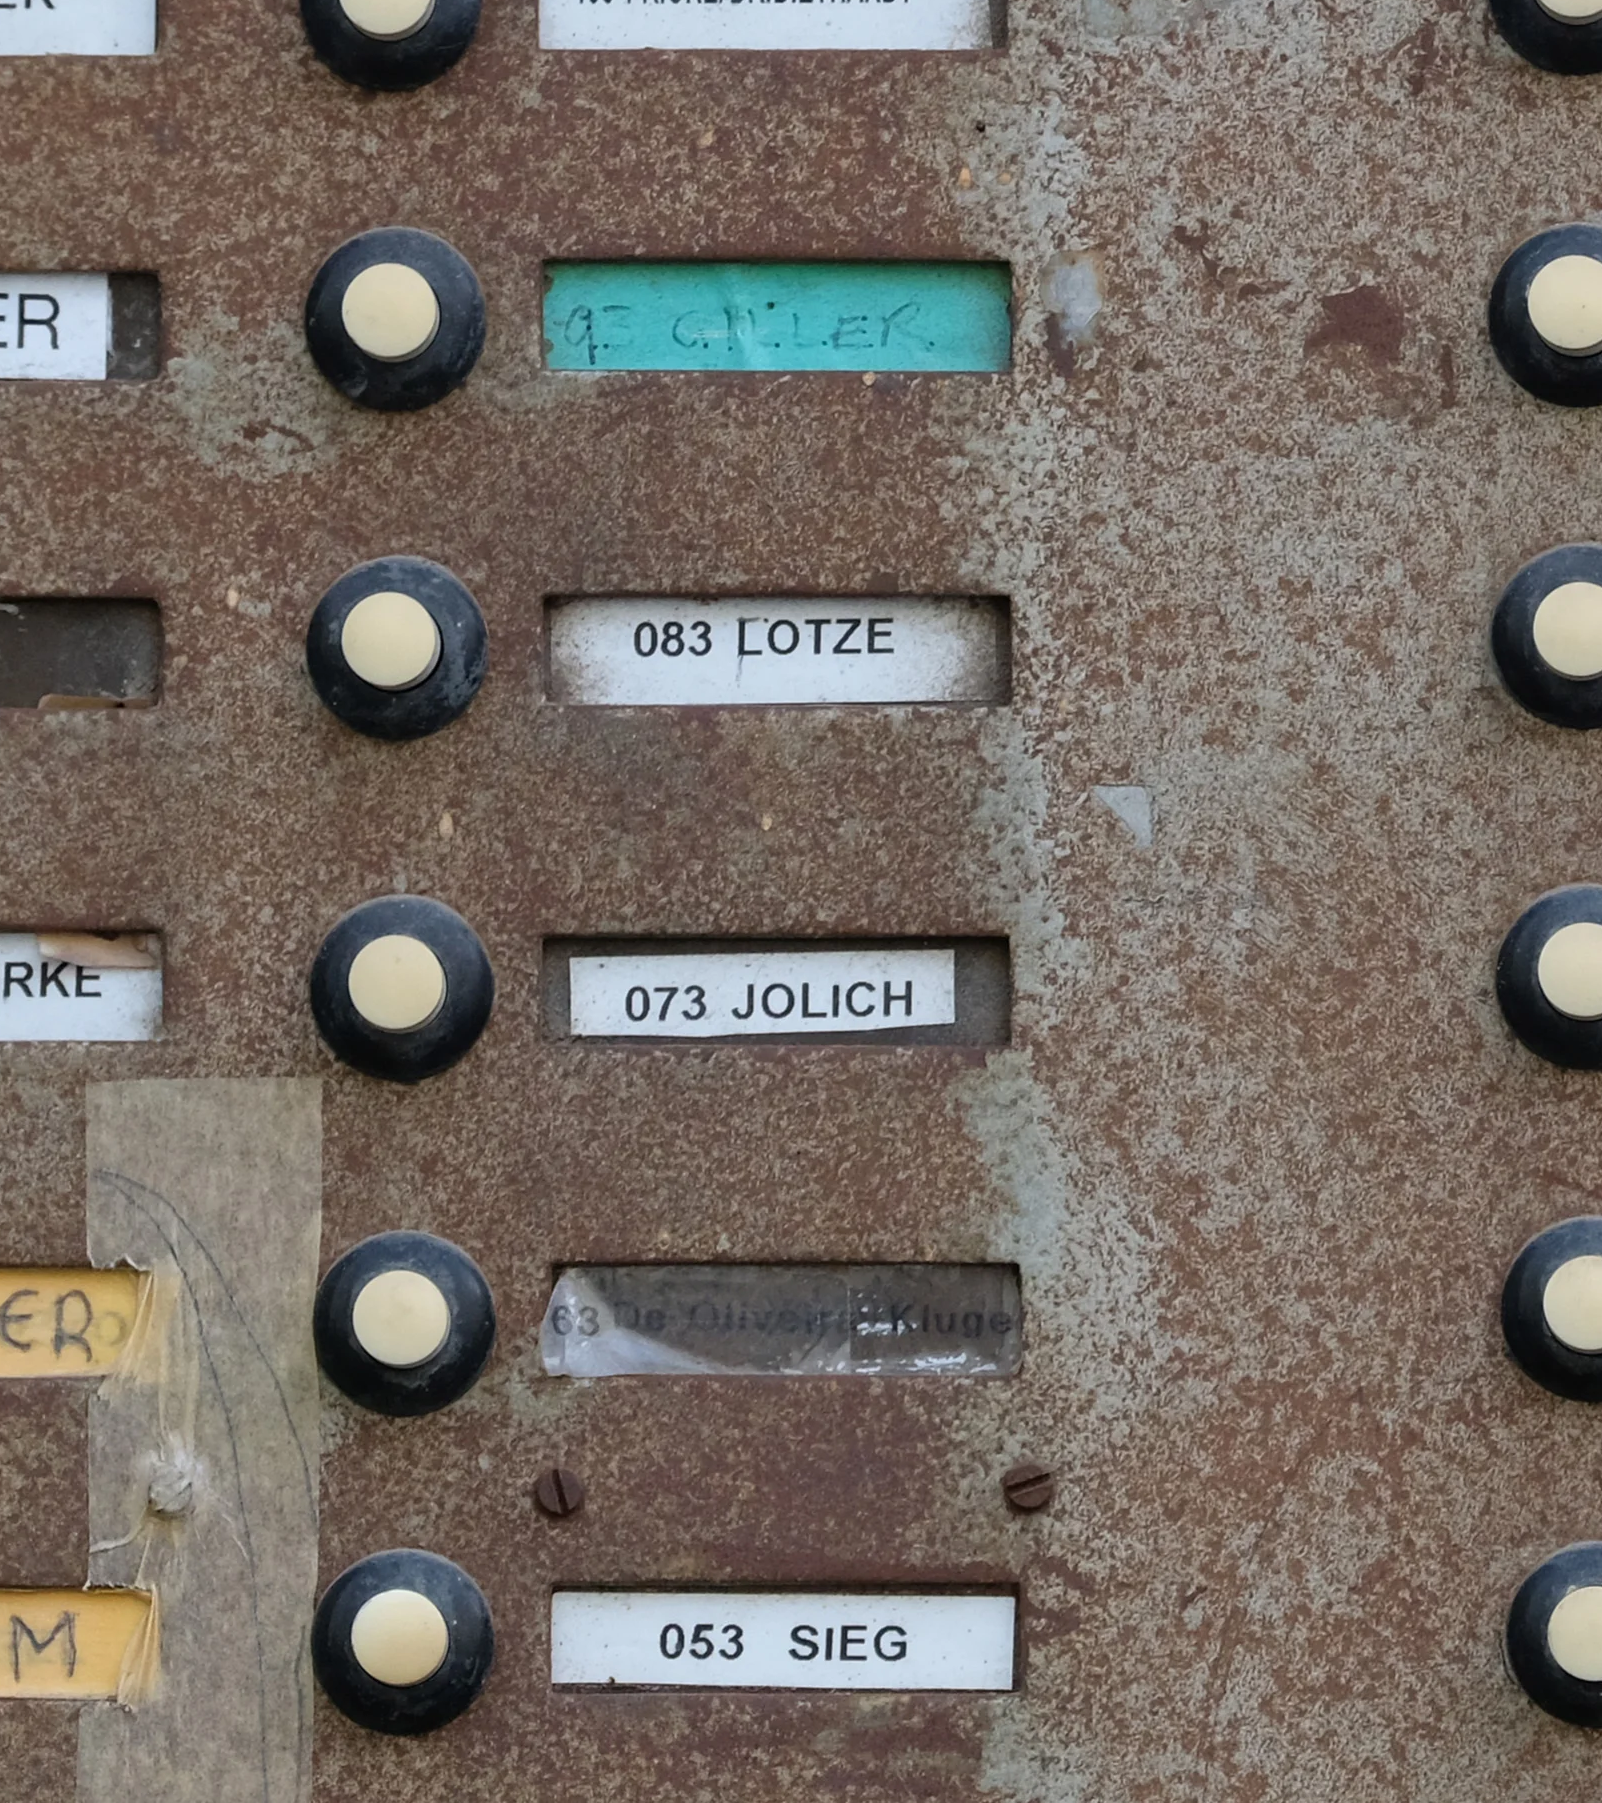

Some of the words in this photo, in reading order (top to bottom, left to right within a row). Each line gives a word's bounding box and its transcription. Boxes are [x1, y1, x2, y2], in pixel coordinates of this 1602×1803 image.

[633, 620, 712, 658] 083
[736, 616, 895, 657] LOTZE
[625, 984, 707, 1022] 073
[731, 980, 913, 1020] JOLICH
[552, 1302, 600, 1341] 63
[659, 1623, 744, 1660] 053
[788, 1624, 907, 1662] SIEG
